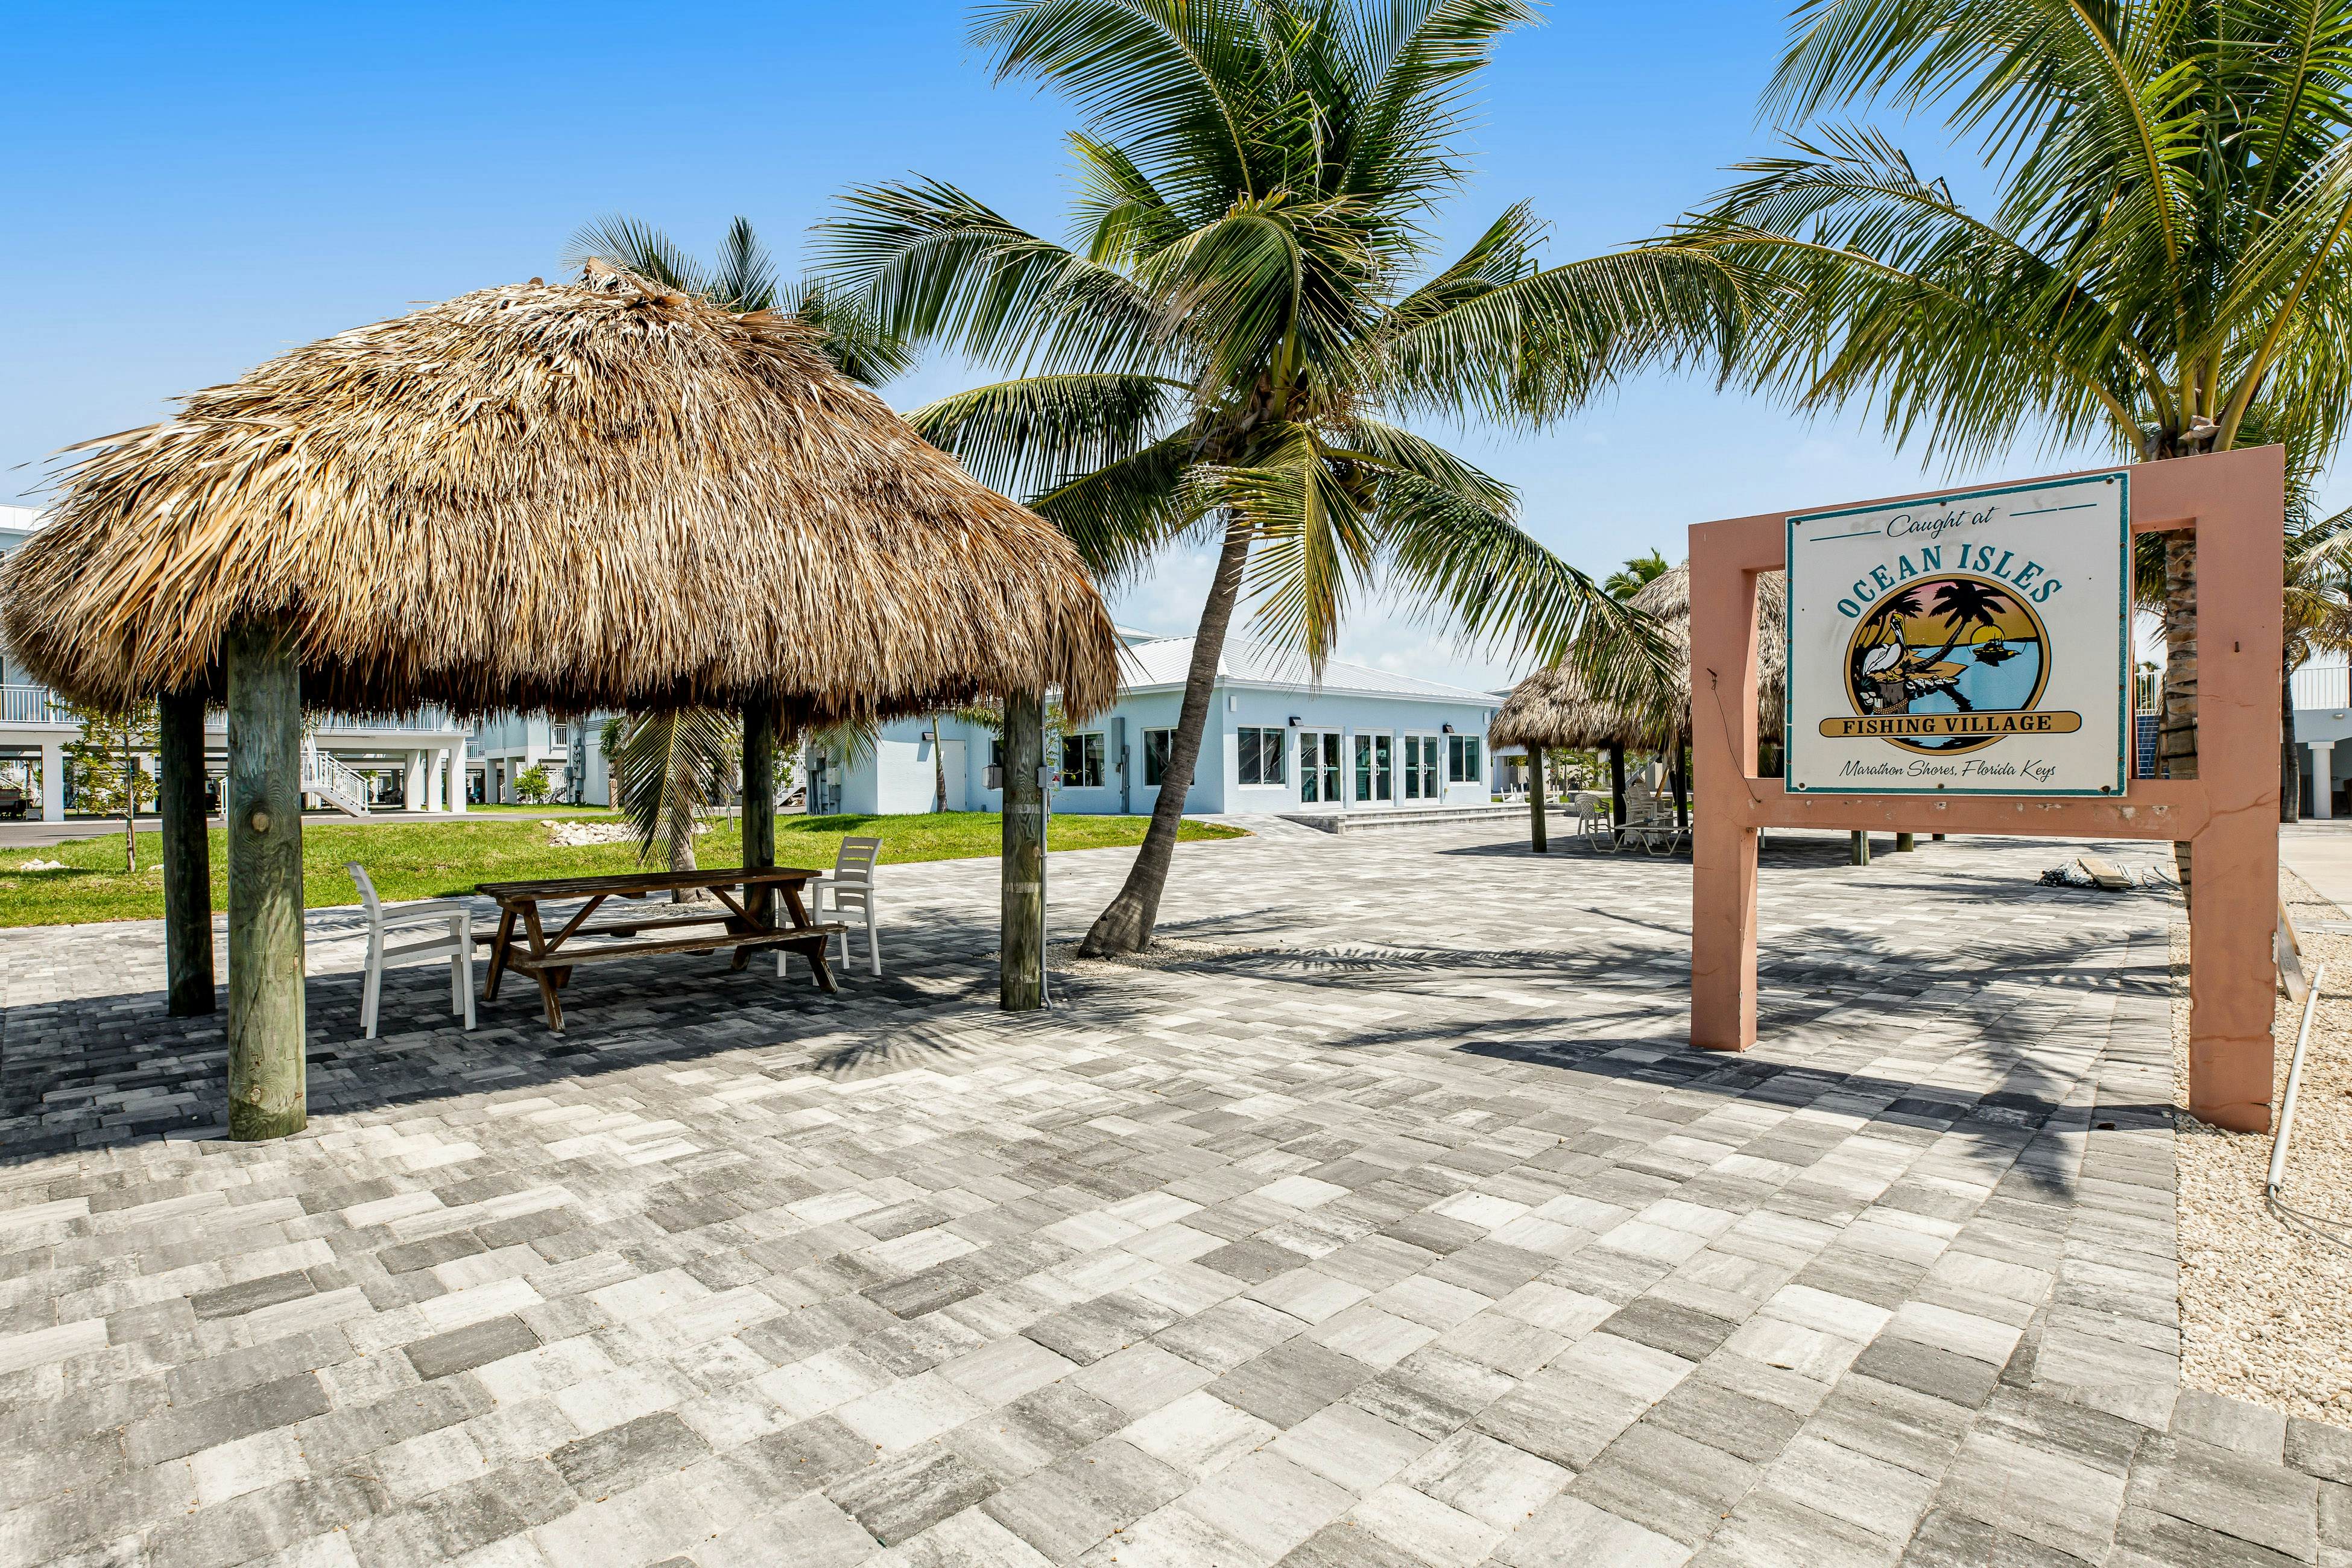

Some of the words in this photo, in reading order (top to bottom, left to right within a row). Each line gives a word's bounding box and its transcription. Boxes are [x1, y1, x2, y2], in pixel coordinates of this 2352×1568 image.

[1886, 510, 1968, 539] Caught
[1971, 507, 2001, 524] at
[1837, 545, 1942, 618] OCEAN
[1957, 544, 2063, 602] ISLES
[1842, 717, 1936, 735] FISHING
[1944, 715, 2052, 732] VILLAGE
[1839, 760, 1904, 777] Marathon
[1907, 760, 1958, 777] Shores,
[1962, 760, 2016, 777] Florida
[2020, 759, 2056, 782] Keys
